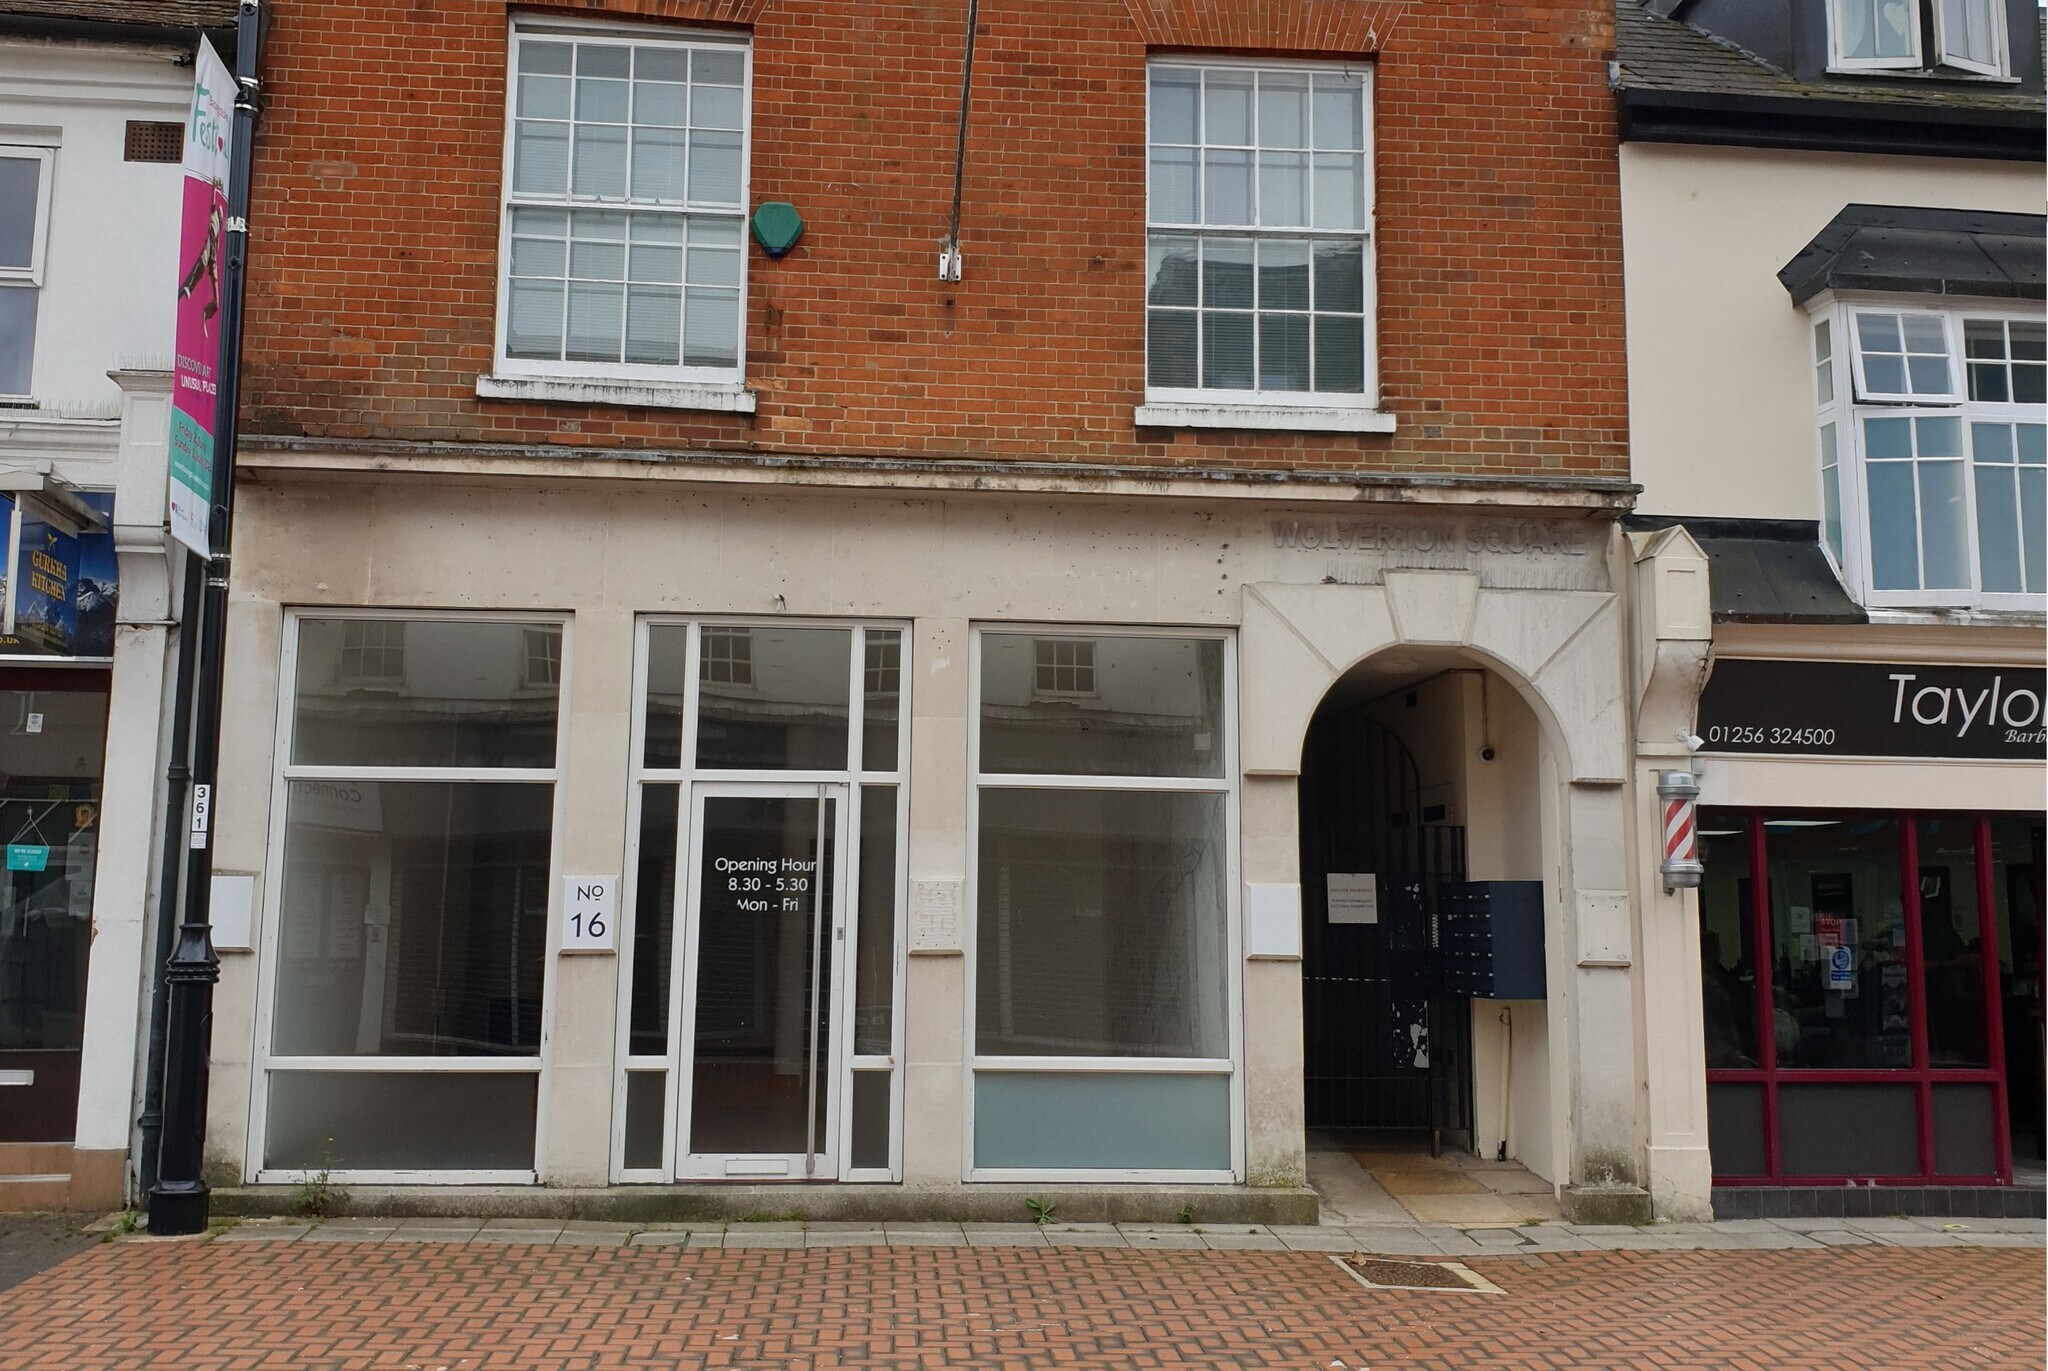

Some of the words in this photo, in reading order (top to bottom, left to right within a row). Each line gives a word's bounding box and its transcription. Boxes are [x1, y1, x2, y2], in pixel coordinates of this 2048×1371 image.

[1708, 725, 1765, 743] 01256
[1769, 727, 1835, 745] 324500
[2004, 728, 2047, 744] Barb
[714, 857, 778, 875] Opening
[781, 858, 816, 872] Hour
[728, 877, 761, 891] 8.30
[775, 878, 808, 891] 5.30
[736, 898, 768, 911] Mon
[782, 897, 799, 911] Fri
[571, 912, 606, 938] 16
